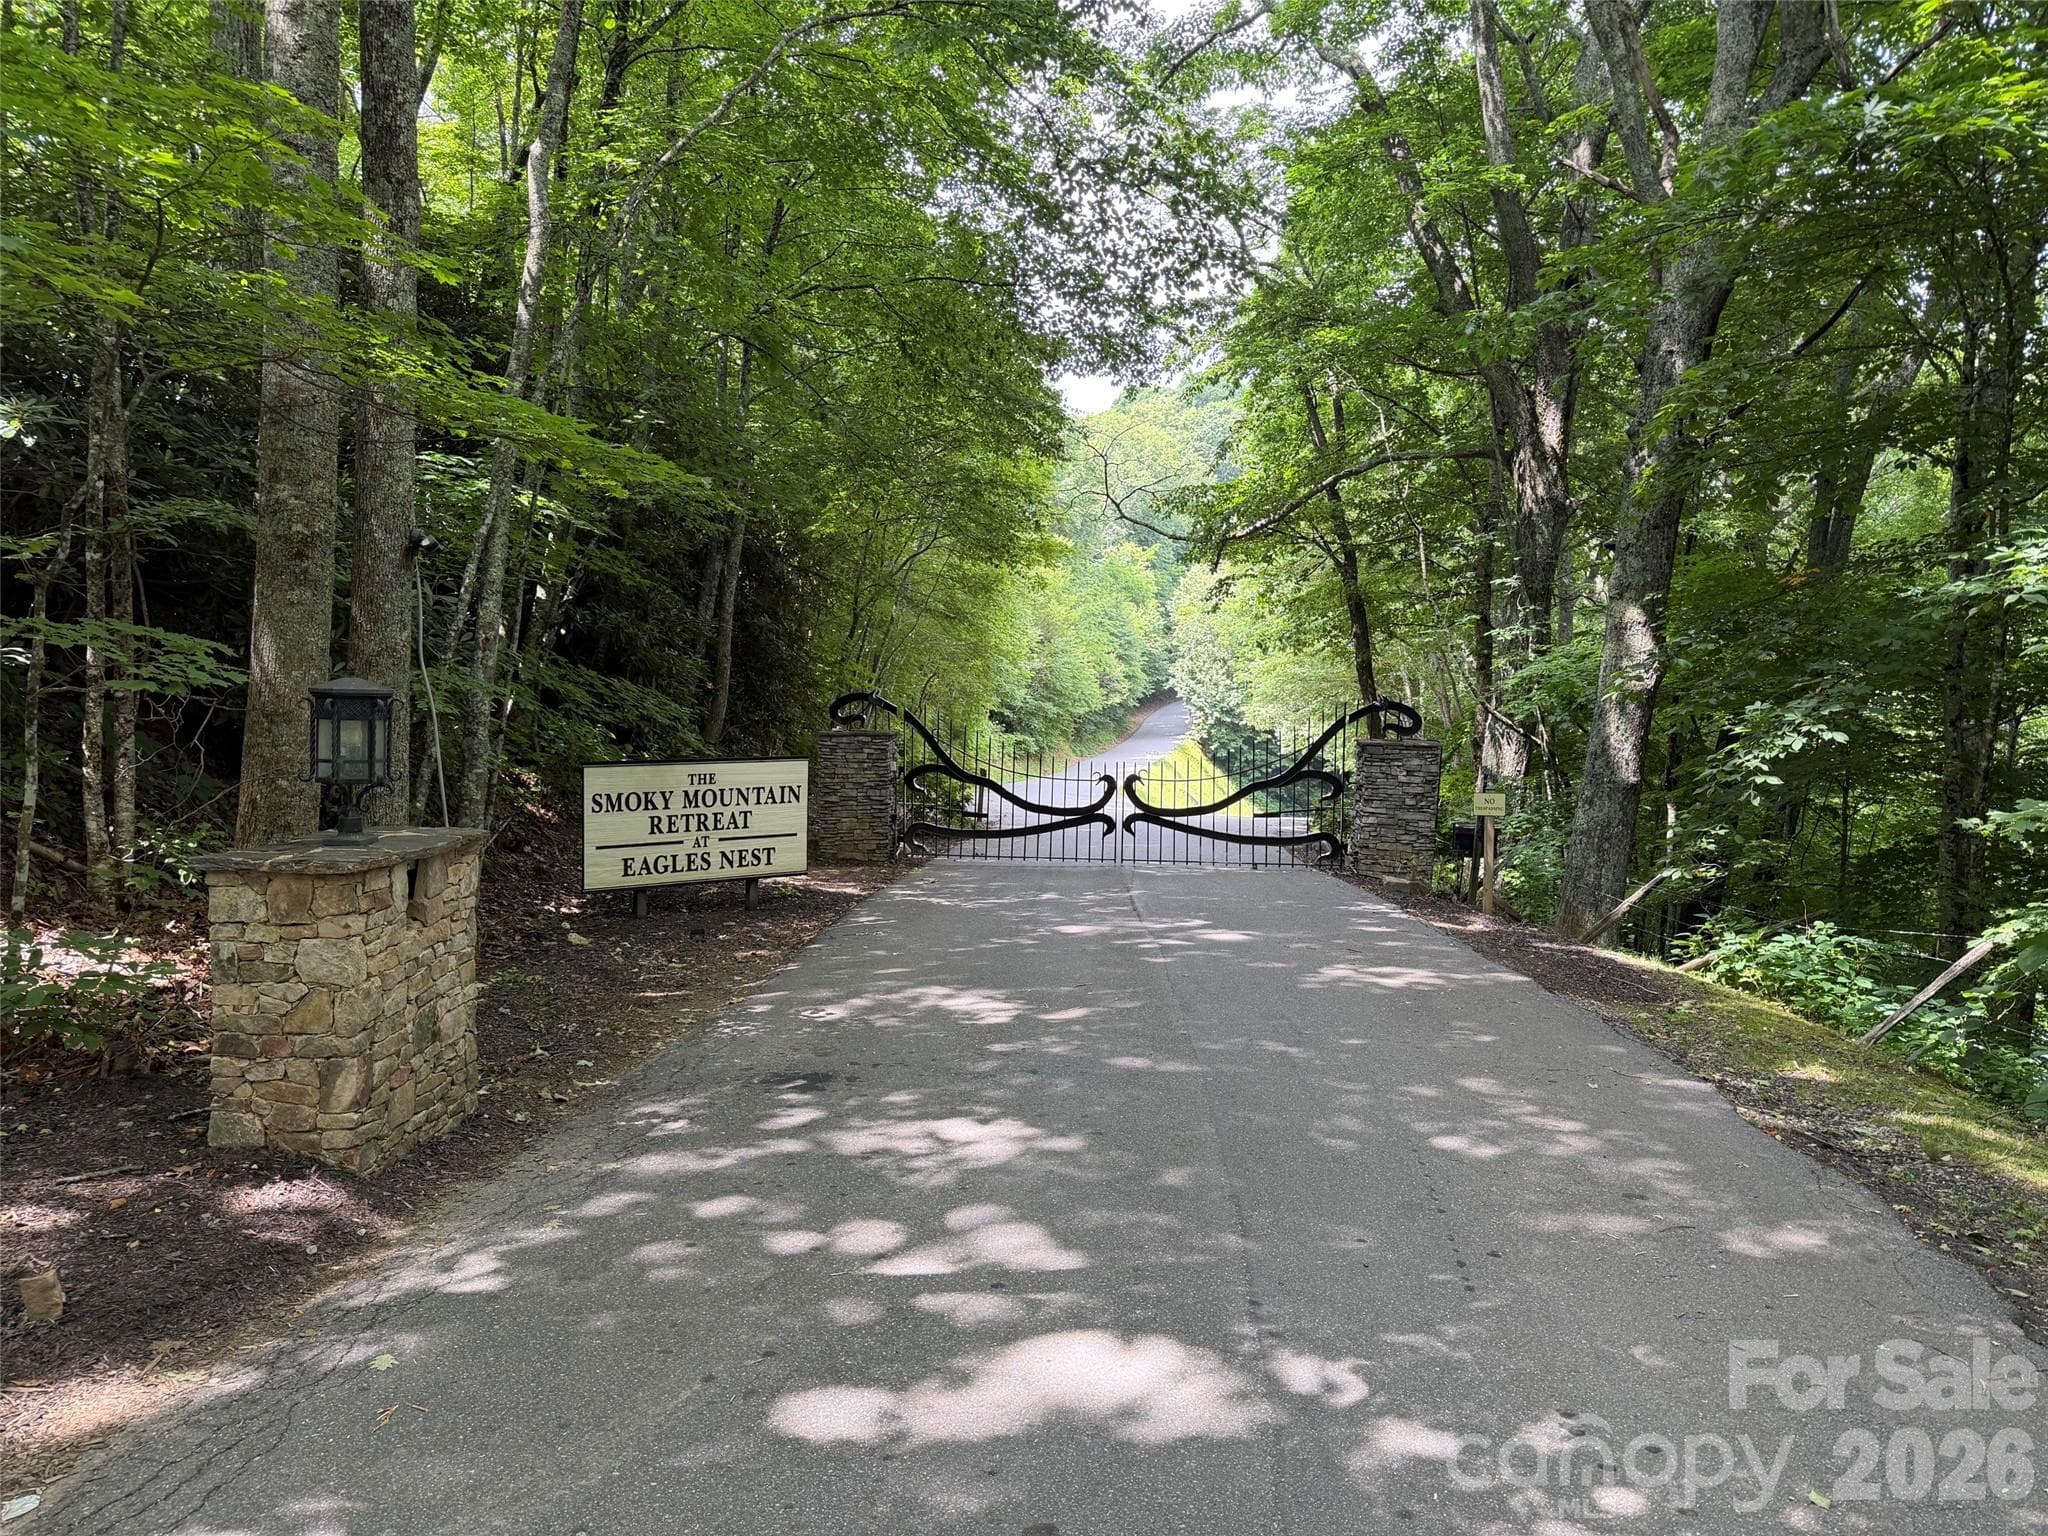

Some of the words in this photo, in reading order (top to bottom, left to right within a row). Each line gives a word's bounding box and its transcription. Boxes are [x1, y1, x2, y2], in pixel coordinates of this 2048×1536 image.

[688, 773, 717, 785] THE
[591, 790, 674, 813] SMOKY
[682, 785, 801, 809] MOUNTAIN
[648, 810, 752, 835] RETREAT
[692, 836, 710, 848] AT
[621, 852, 711, 877] EAGLES
[719, 847, 776, 869] NEST
